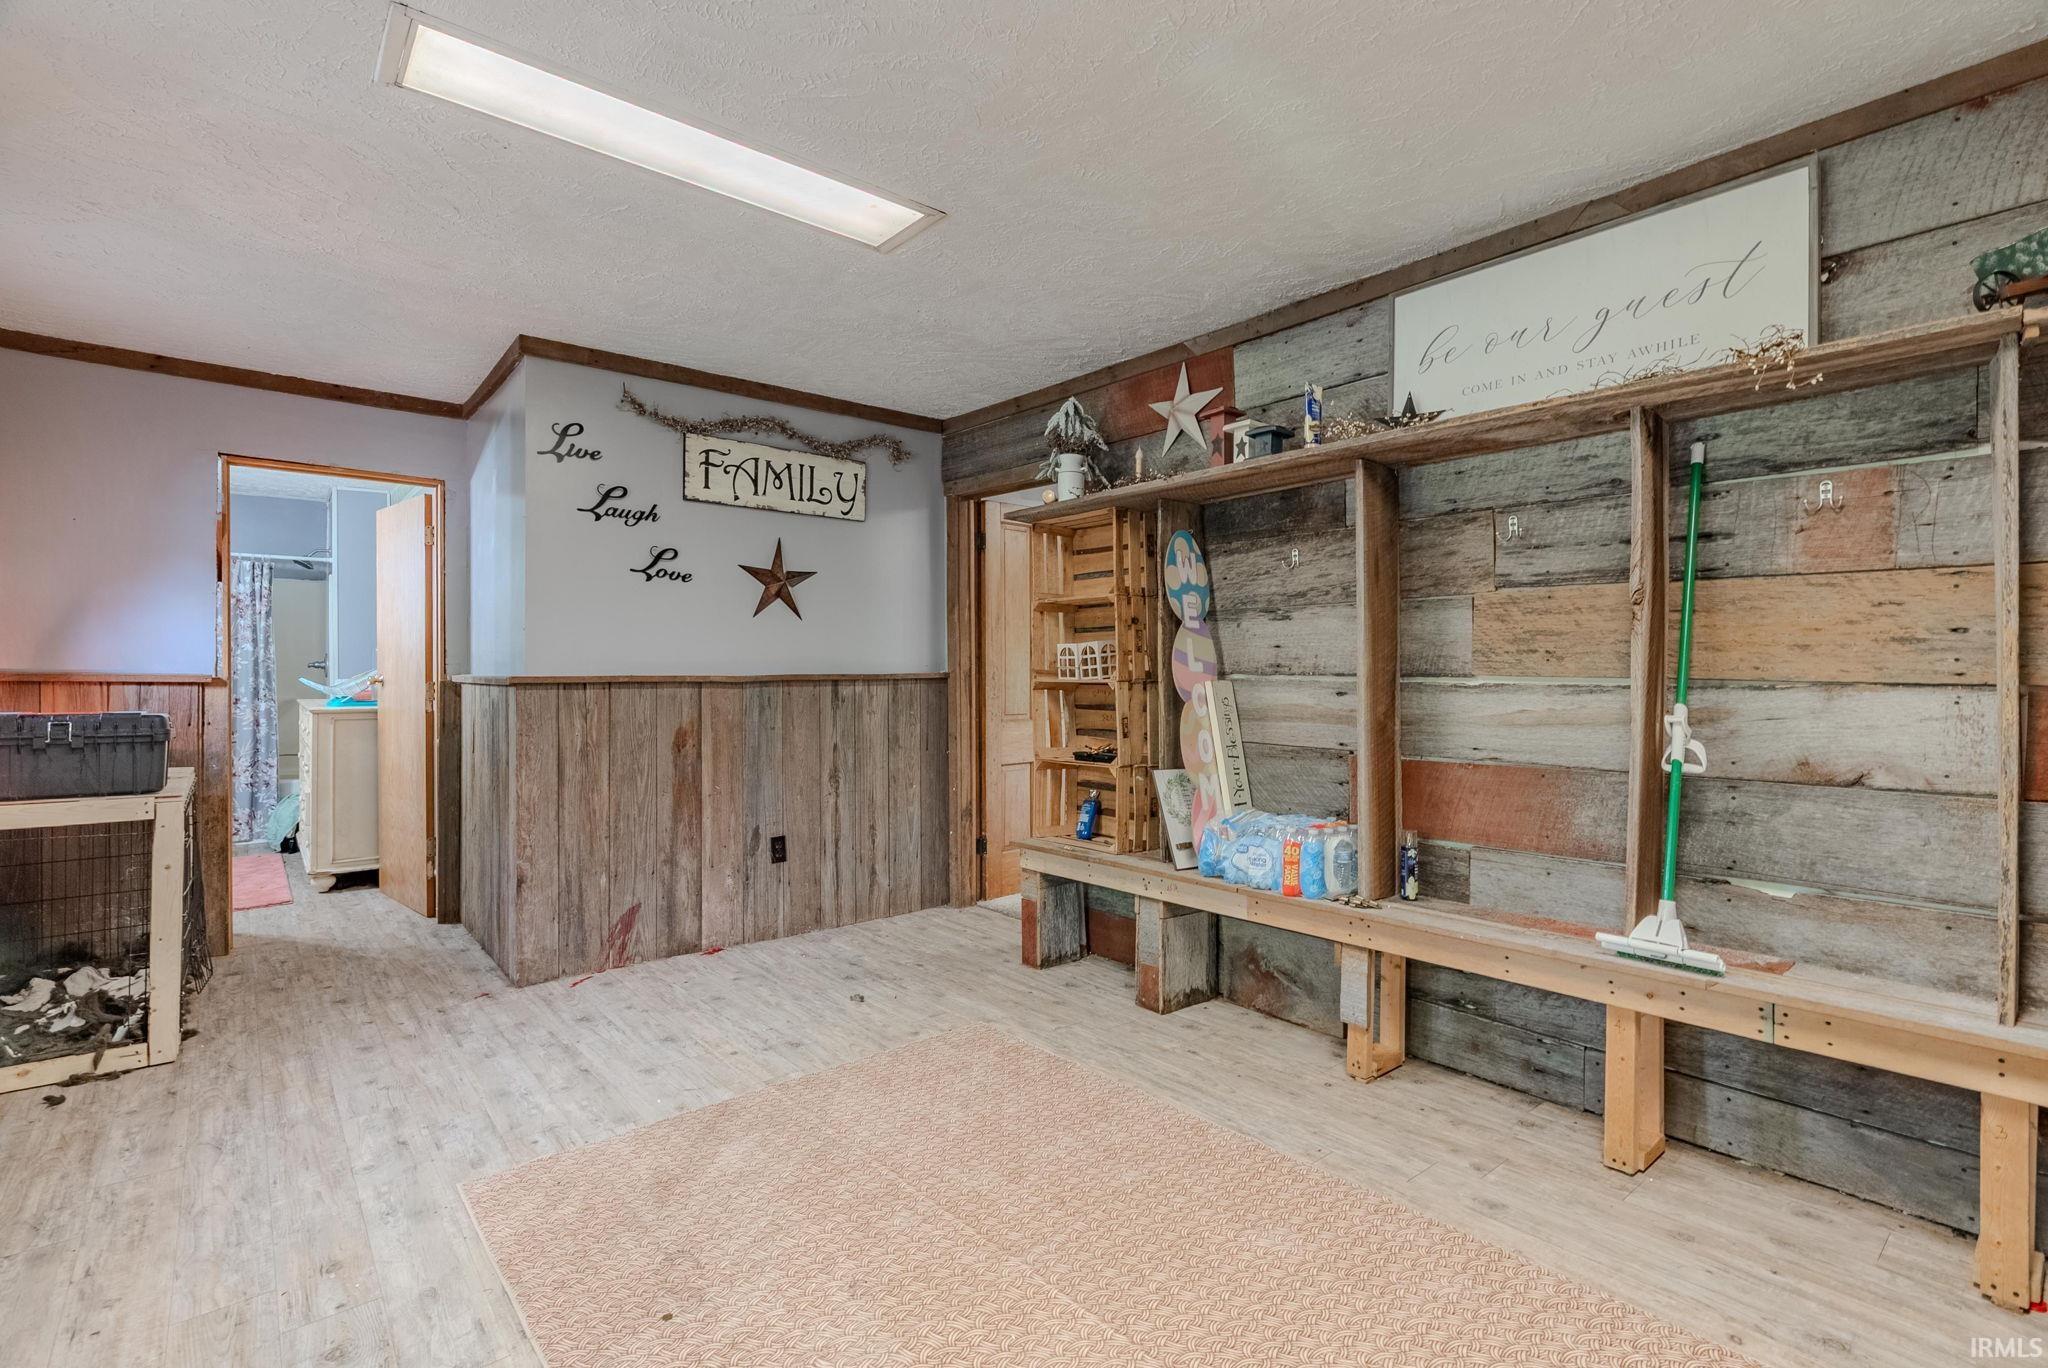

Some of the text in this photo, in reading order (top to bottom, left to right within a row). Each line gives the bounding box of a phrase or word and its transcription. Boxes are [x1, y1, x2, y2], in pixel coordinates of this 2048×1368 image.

[1418, 240, 1768, 376] be our guest
[1461, 333, 1702, 398] COME IN AND STAY AWHILE
[537, 422, 603, 464] Live
[577, 483, 660, 527] Laugh
[698, 448, 859, 516] FAMILY
[629, 545, 694, 583] Love
[1176, 550, 1222, 820] WELCOM
[1284, 846, 1299, 856] 40
